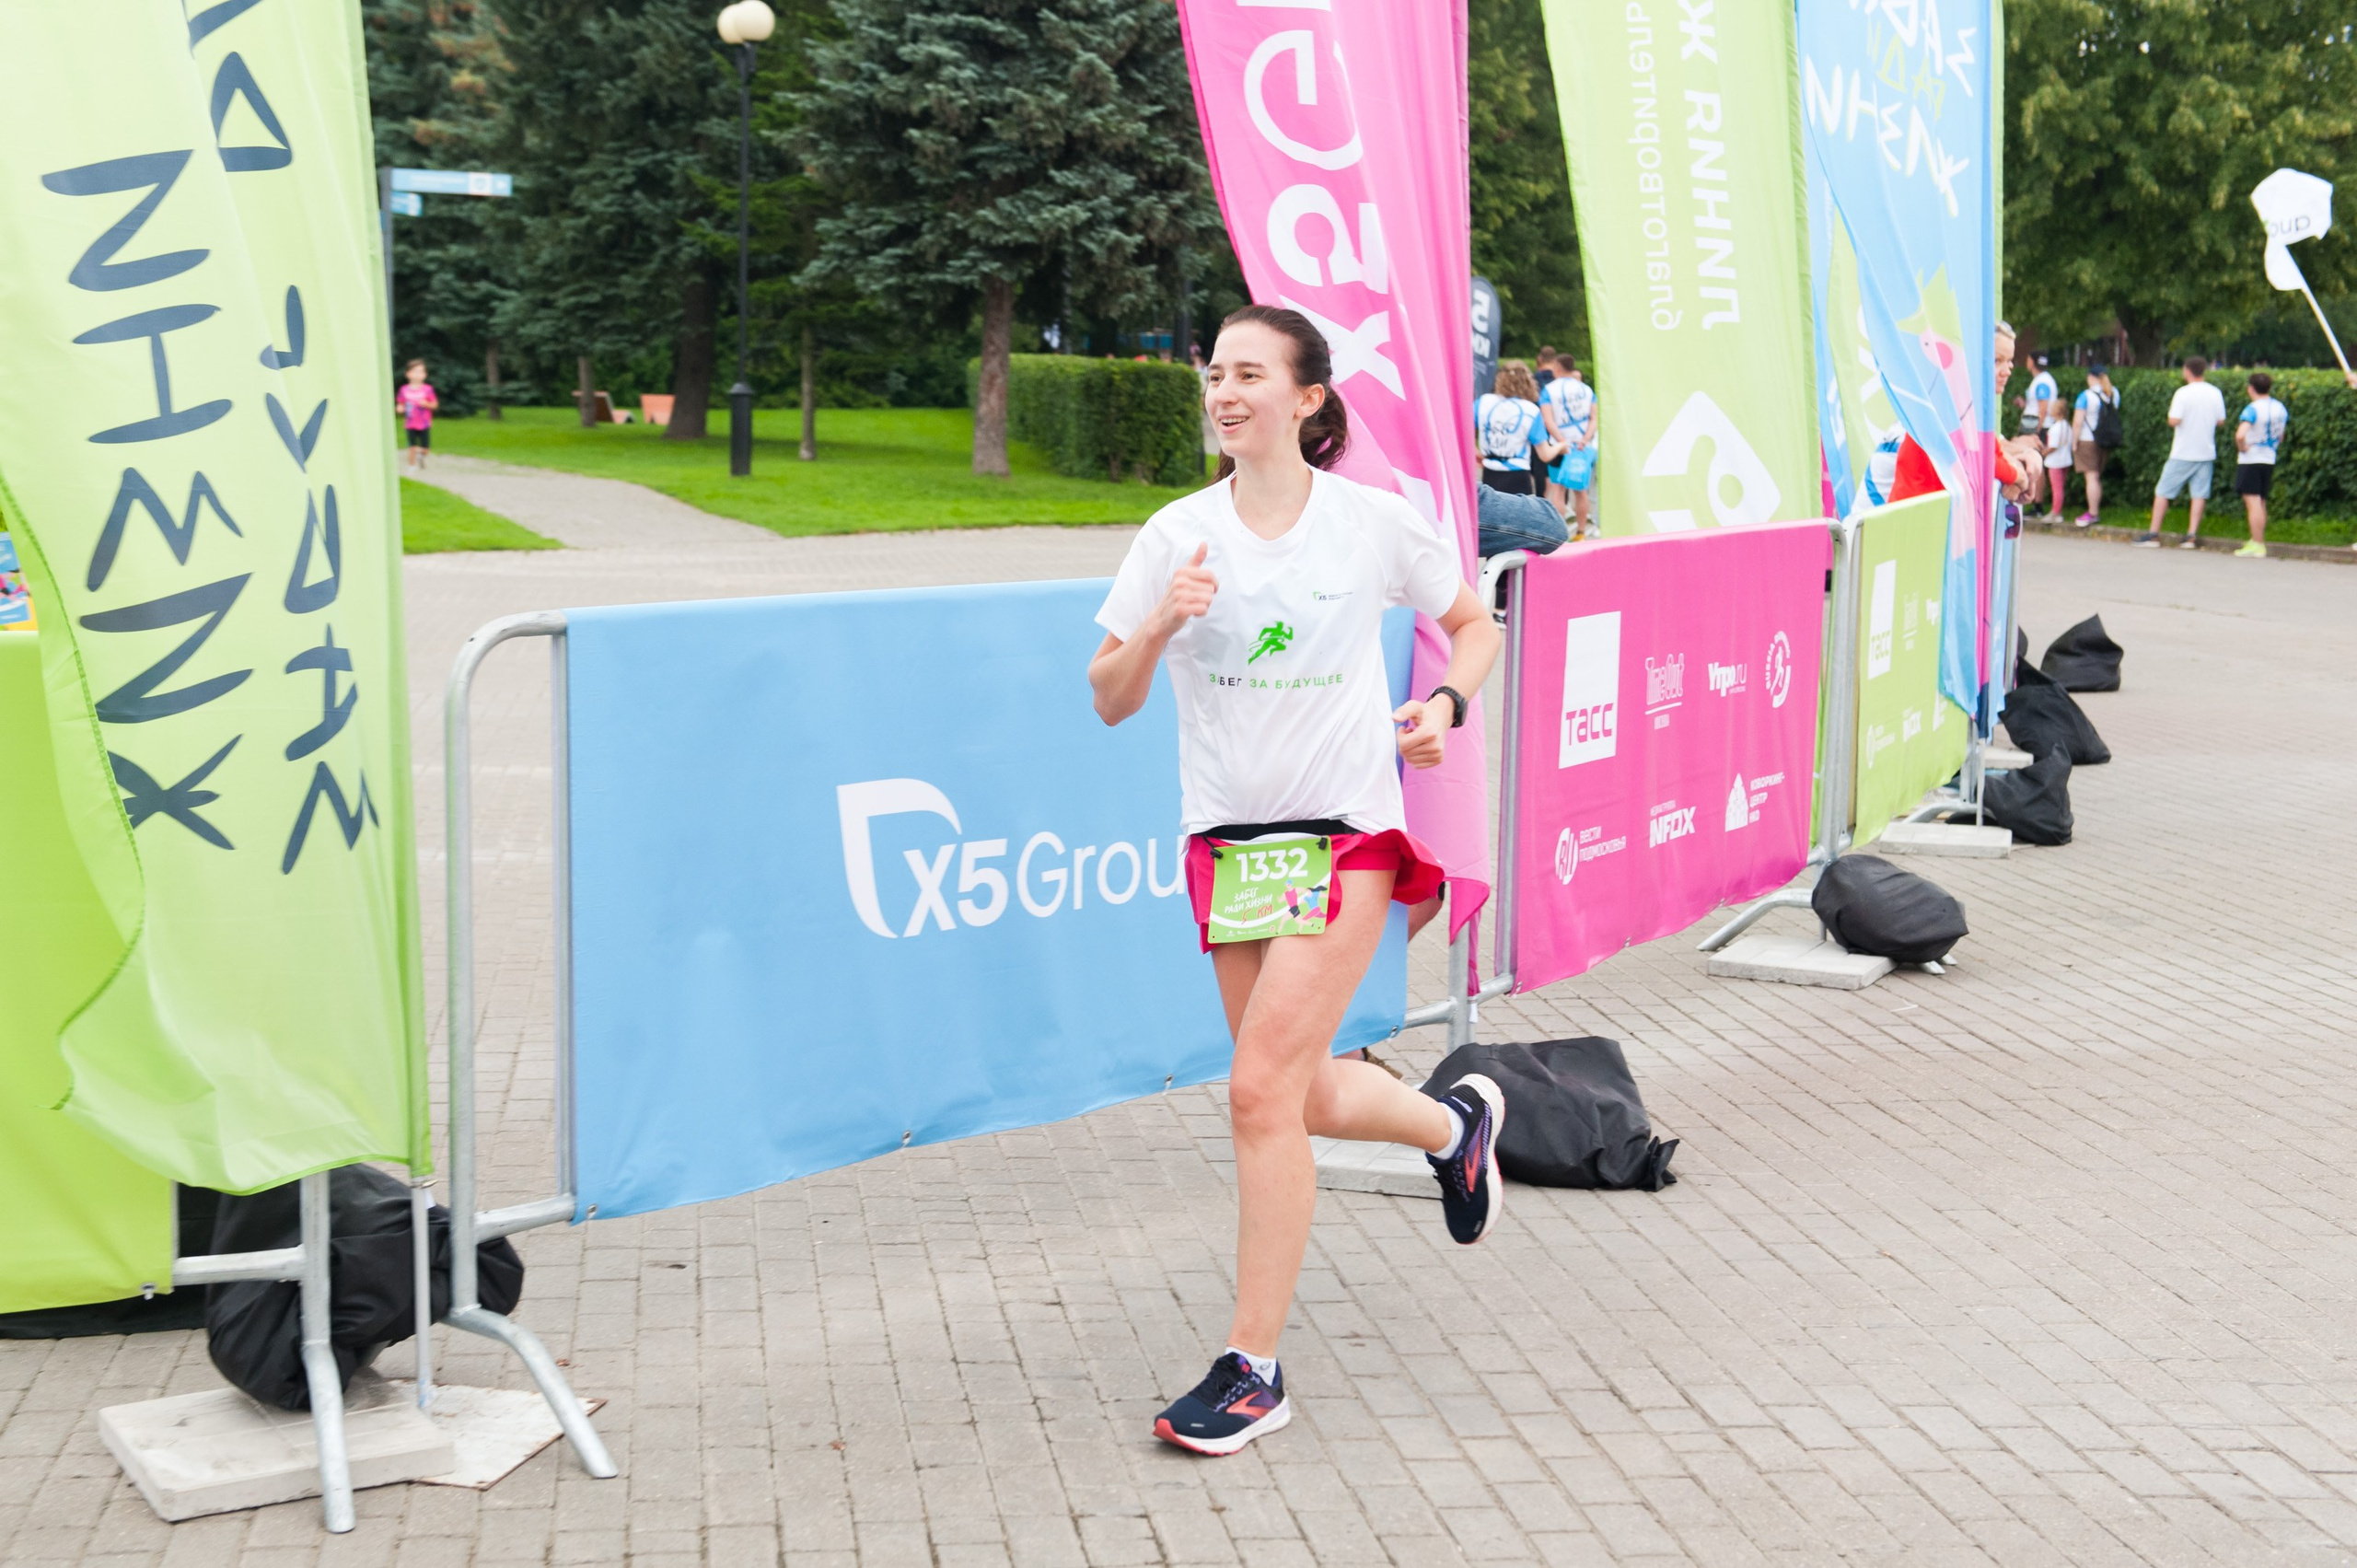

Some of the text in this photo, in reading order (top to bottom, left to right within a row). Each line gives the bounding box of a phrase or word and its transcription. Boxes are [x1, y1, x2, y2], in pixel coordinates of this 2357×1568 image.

[1209, 673, 1343, 690] ЗБЕГ ЗА БУДУЩЕЕ
[1236, 847, 1308, 883] 1332
[902, 837, 1009, 938] X5
[1234, 887, 1259, 903] ЗАБЕГ
[1225, 894, 1273, 914] РАДИ ЖИЗНИ
